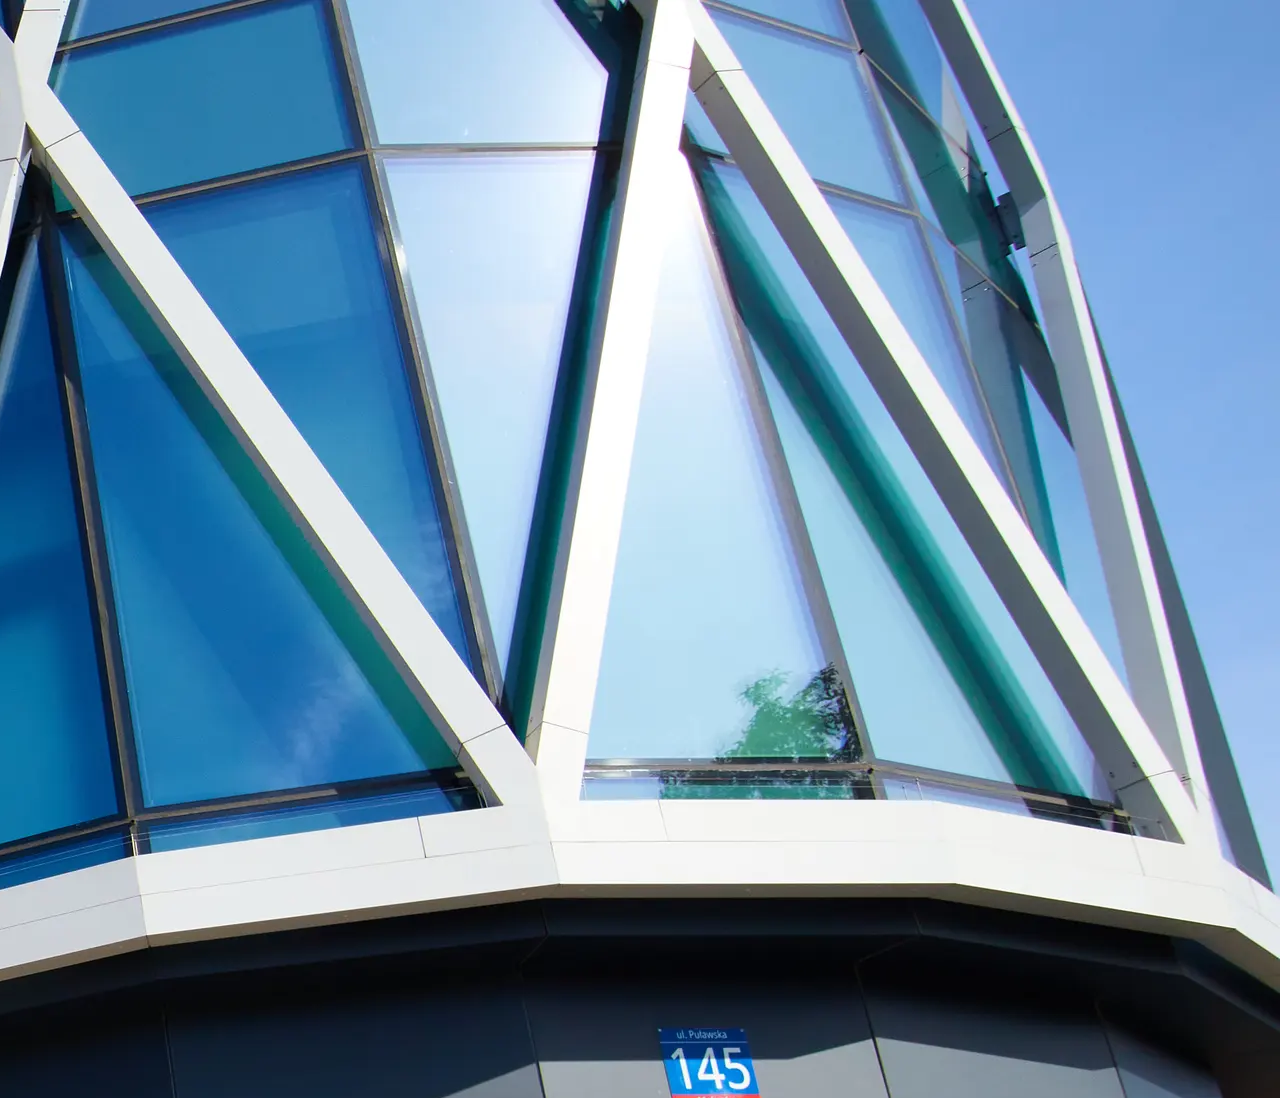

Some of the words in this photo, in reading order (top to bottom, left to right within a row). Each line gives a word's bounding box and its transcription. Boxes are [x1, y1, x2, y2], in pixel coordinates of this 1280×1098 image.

[677, 1031, 687, 1039] ul.
[689, 1030, 728, 1039] Puławska
[671, 1047, 751, 1090] 145
